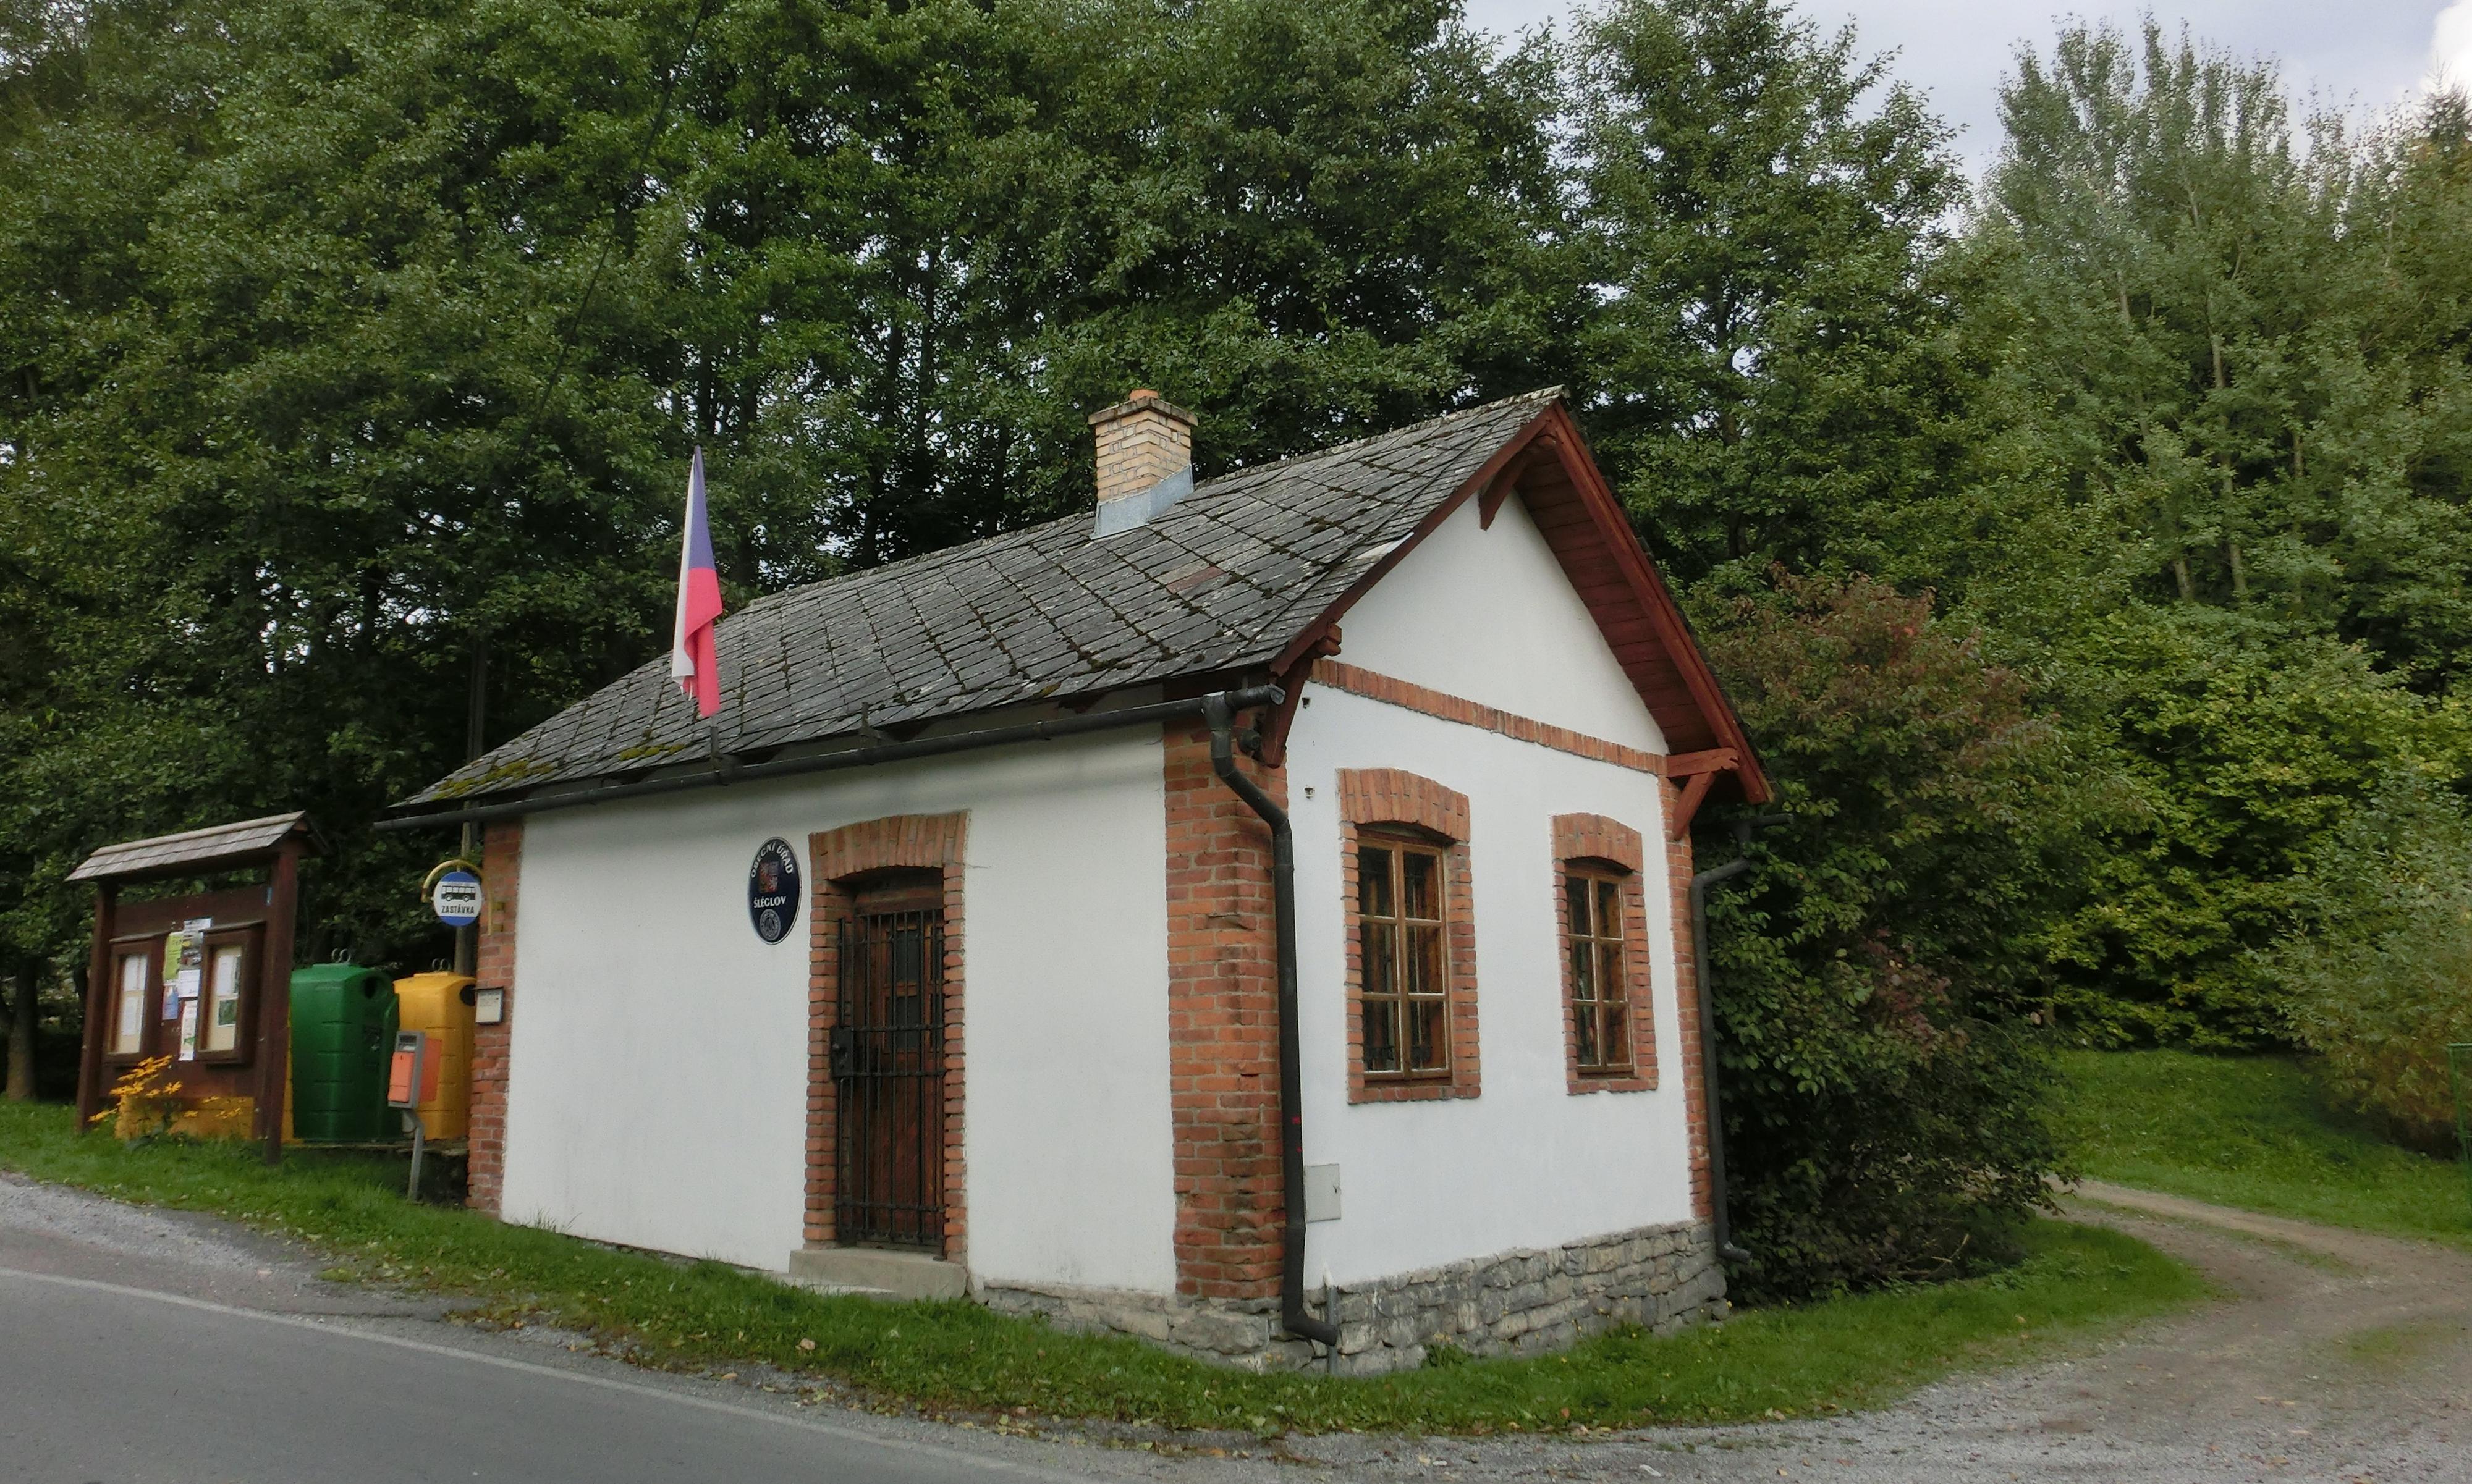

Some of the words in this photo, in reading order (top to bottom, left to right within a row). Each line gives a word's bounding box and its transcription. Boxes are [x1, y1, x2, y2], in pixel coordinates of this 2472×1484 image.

[751, 841, 777, 878] OBECNÍ
[776, 844, 794, 874] ÚŘAD
[441, 904, 475, 914] ZASTÁVKA
